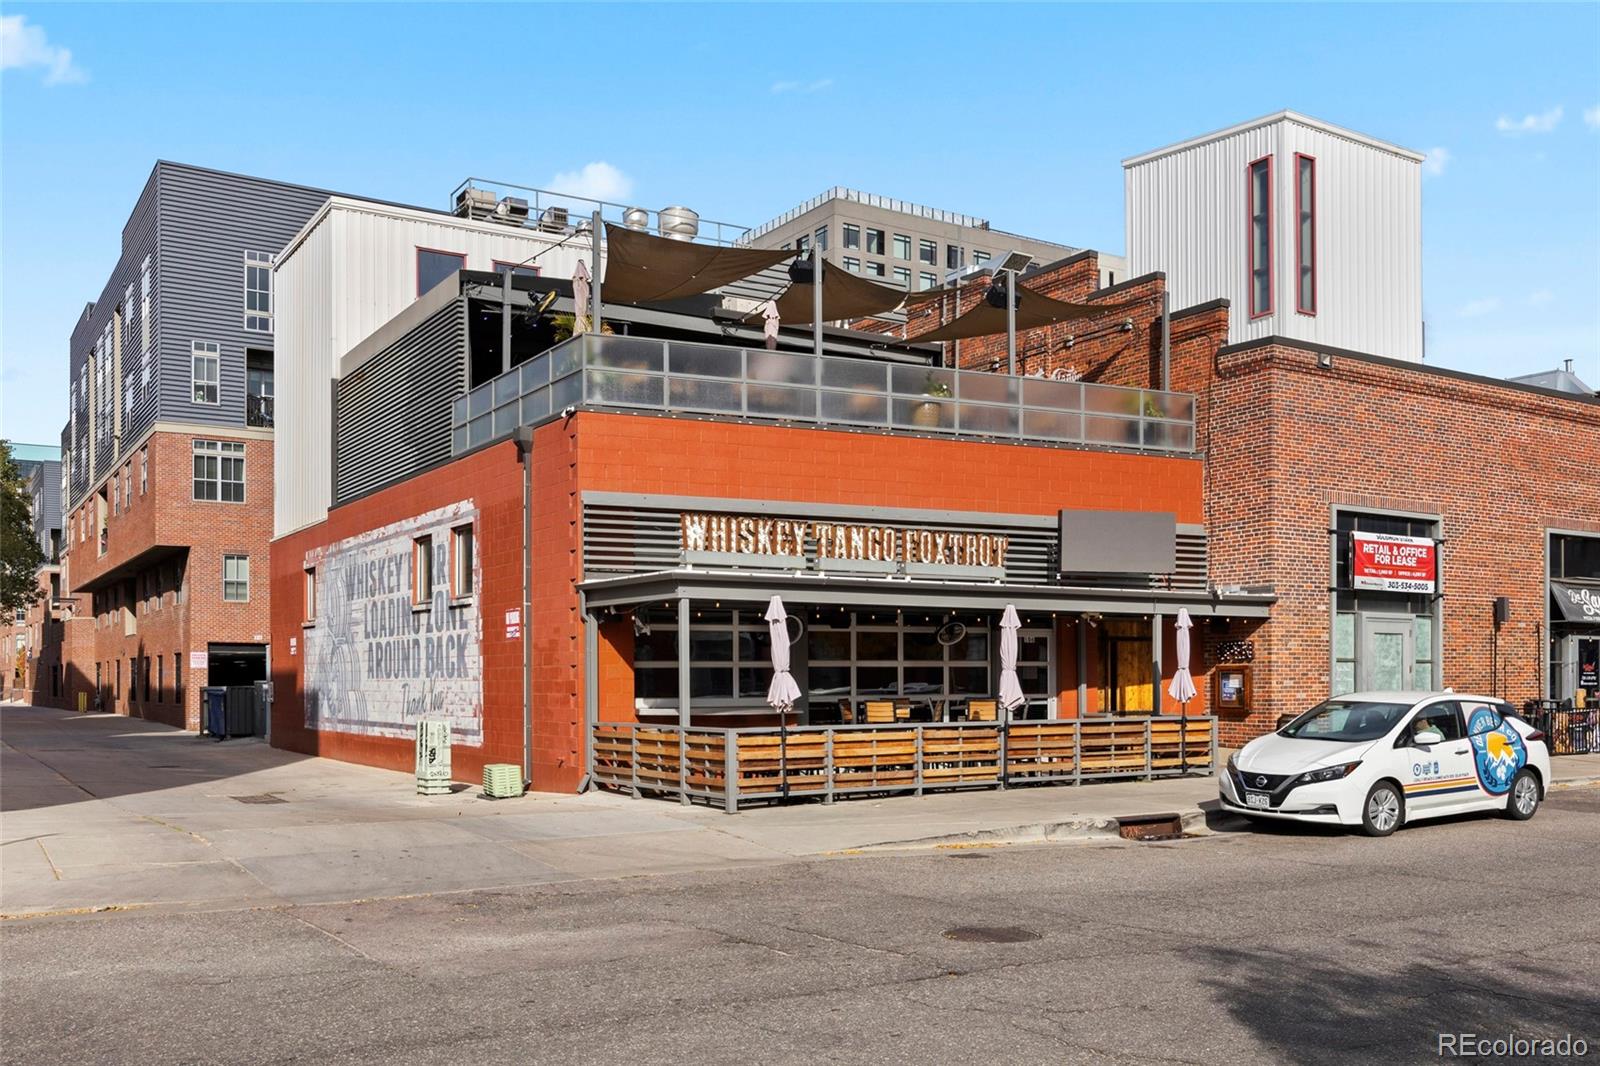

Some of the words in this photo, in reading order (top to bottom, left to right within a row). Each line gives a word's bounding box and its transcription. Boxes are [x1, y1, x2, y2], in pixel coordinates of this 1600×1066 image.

[680, 512, 808, 557] WHISKEY
[813, 521, 897, 562] TANGO
[902, 528, 1009, 568] FOXTROT
[1363, 543, 1391, 556] RETAIL
[1392, 546, 1399, 556] &
[1399, 546, 1428, 558] OFFICE
[1374, 554, 1391, 565] FOR
[1392, 555, 1417, 567] LEASE
[345, 552, 404, 601] WHISKEY
[367, 638, 421, 679] AROUND
[425, 631, 470, 679] BACK
